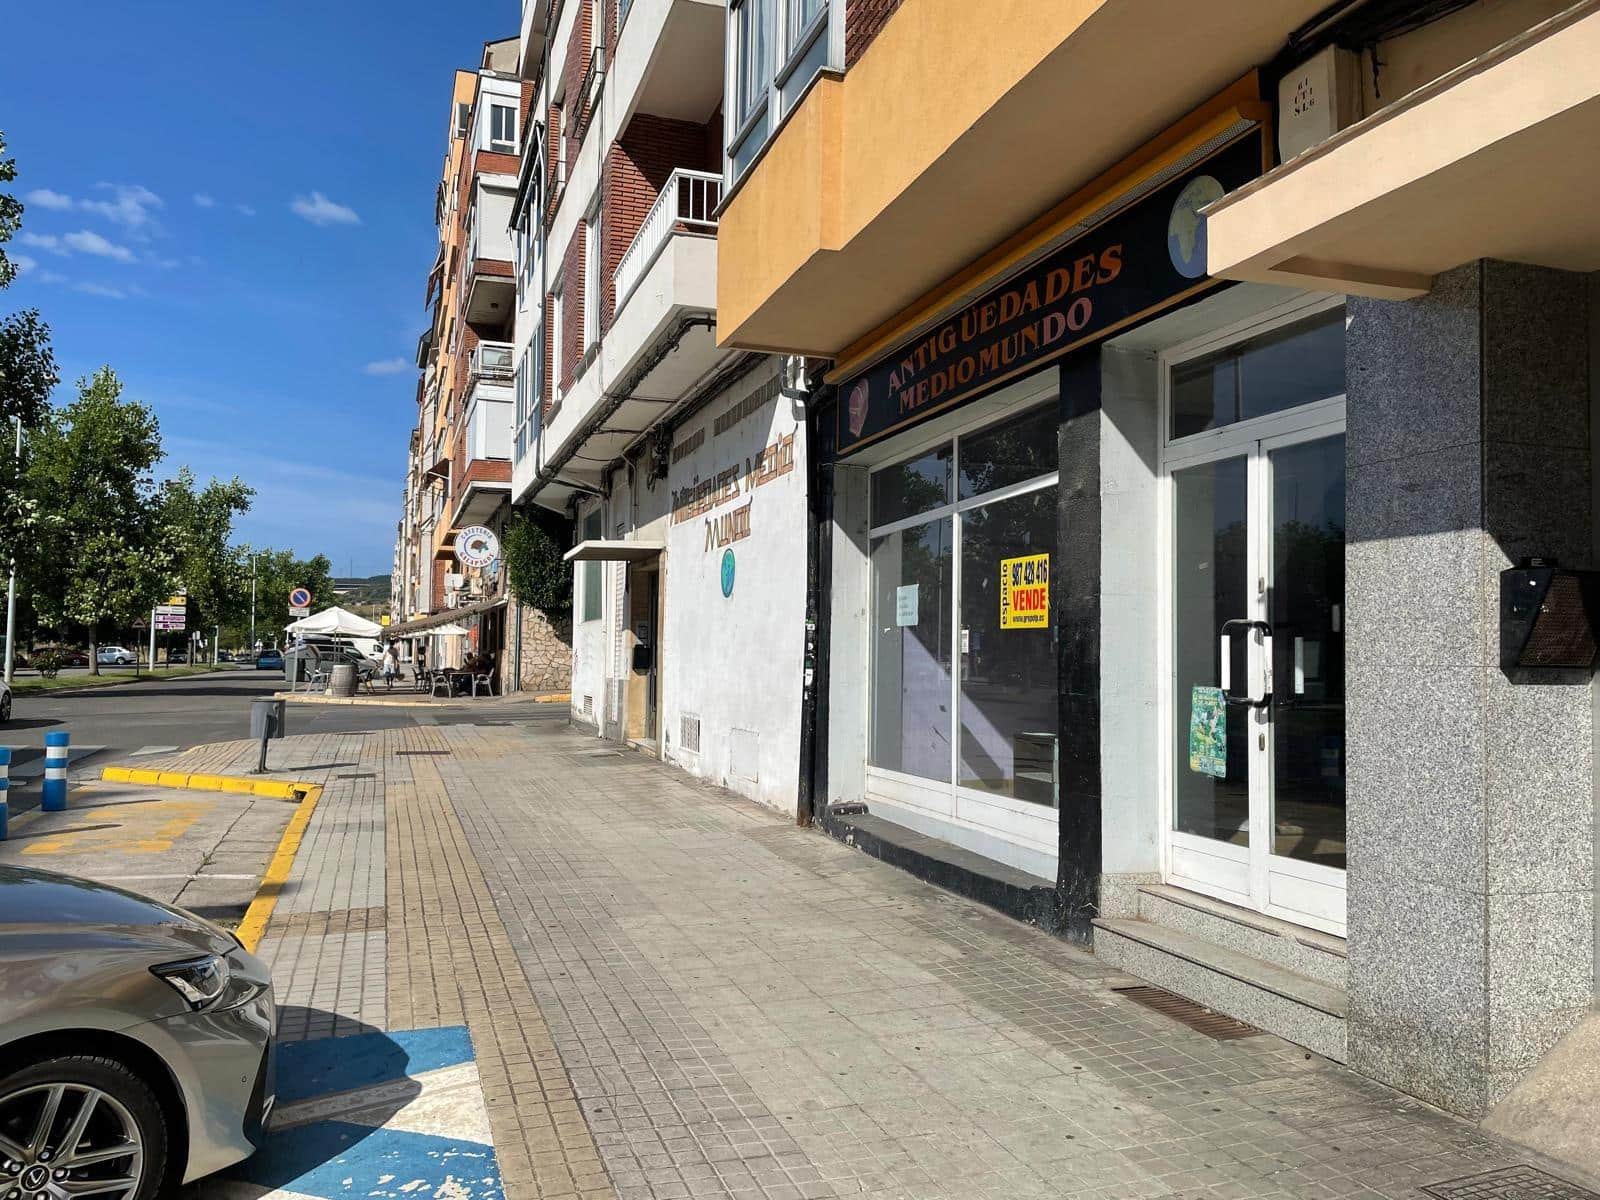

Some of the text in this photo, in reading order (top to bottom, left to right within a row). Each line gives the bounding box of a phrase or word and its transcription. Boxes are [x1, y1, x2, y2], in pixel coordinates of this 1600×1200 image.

[888, 245, 1123, 399] ANTIGÜEDADES
[1002, 563, 1010, 624] espacio
[1013, 559, 1047, 587] 987 428 416
[1013, 588, 1046, 611] VENDE
